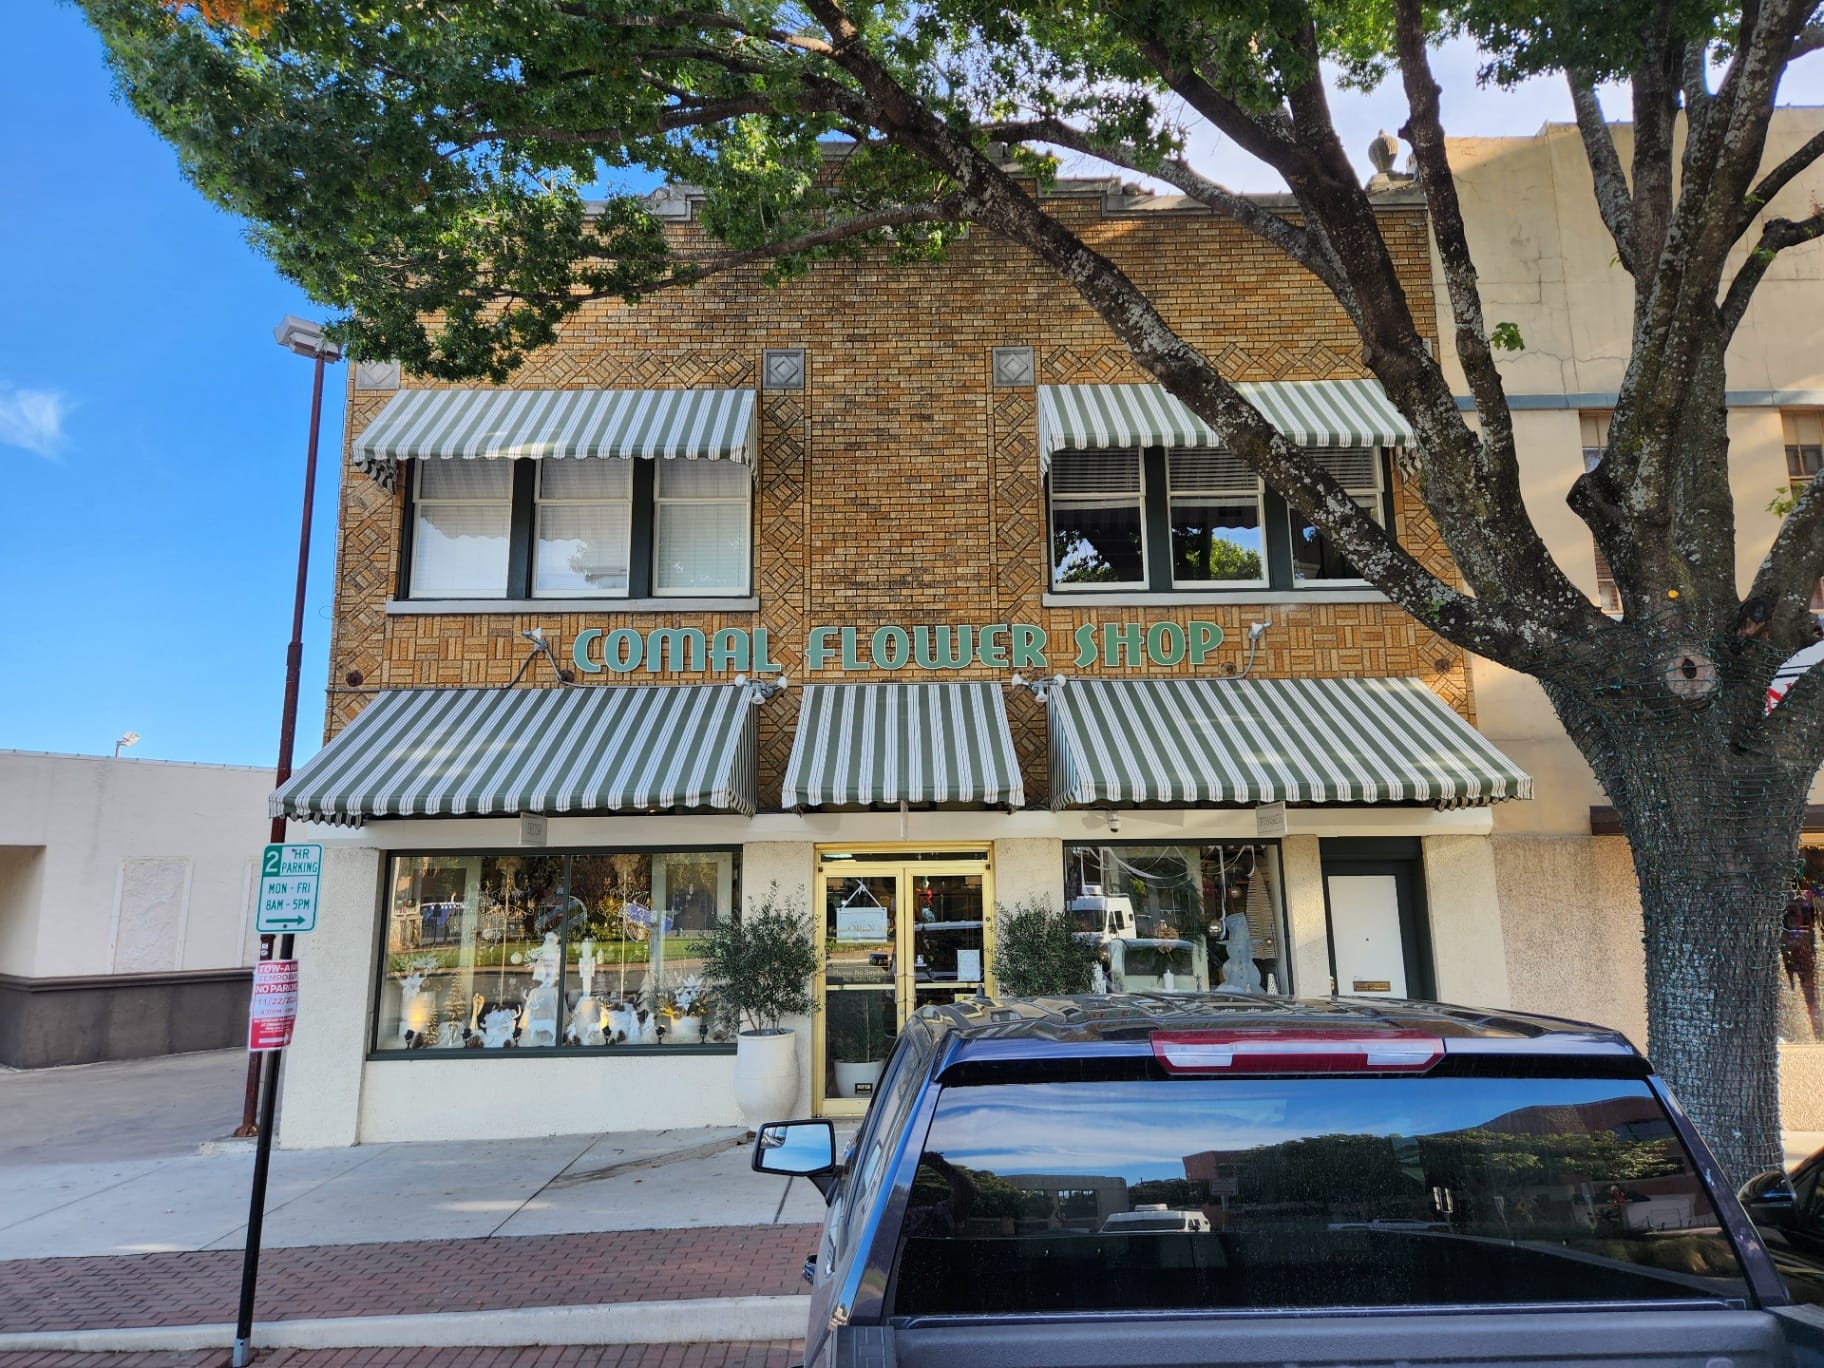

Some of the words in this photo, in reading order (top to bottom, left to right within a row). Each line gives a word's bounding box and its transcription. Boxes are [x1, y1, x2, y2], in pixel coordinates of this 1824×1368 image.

[572, 627, 782, 673] COMAL
[806, 623, 1048, 670] FLOWER
[1073, 620, 1224, 668] SHOP
[265, 850, 280, 873] 2
[294, 848, 310, 859] HR
[281, 861, 318, 873] PARKING
[268, 882, 288, 894] MON
[296, 882, 311, 894] FRI
[265, 899, 284, 910] 8AM
[292, 898, 310, 910] 5PM
[259, 963, 297, 973] TOW-A
[256, 984, 269, 994] NO
